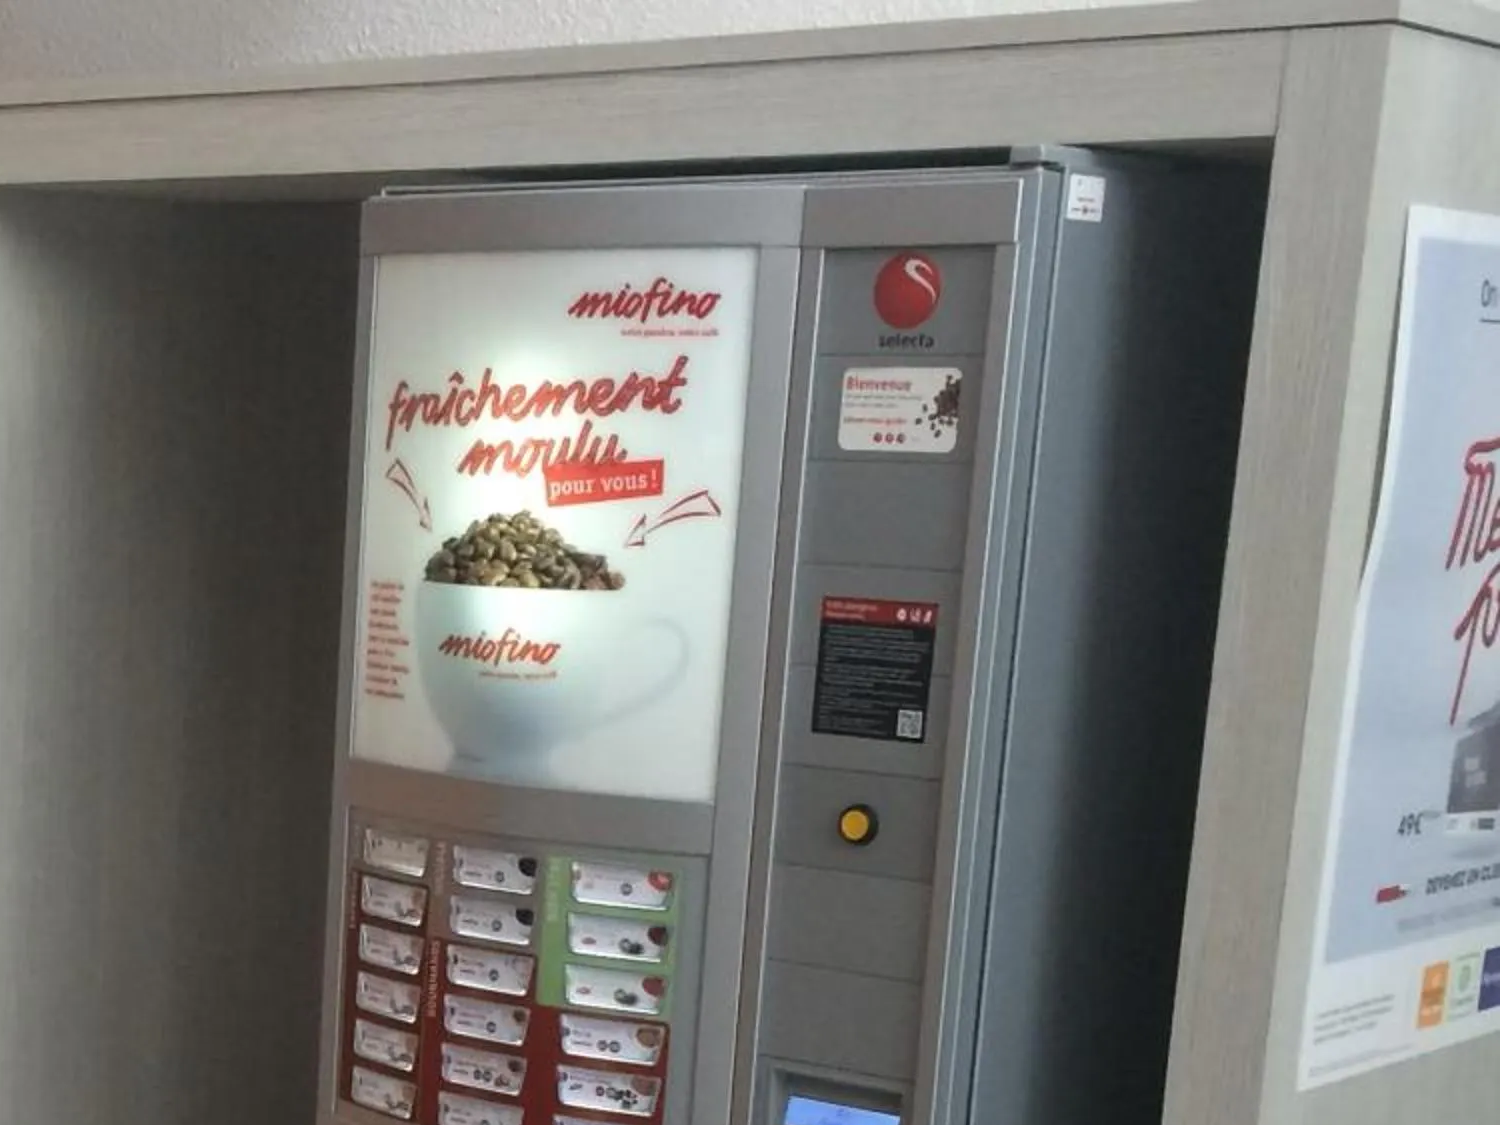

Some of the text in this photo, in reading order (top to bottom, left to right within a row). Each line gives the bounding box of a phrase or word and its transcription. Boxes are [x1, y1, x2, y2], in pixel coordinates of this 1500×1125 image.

[567, 276, 722, 323] miofino
[878, 333, 935, 349] selecta
[385, 355, 690, 450] fraîchement
[549, 477, 598, 500] pour
[438, 627, 562, 668] miofino
